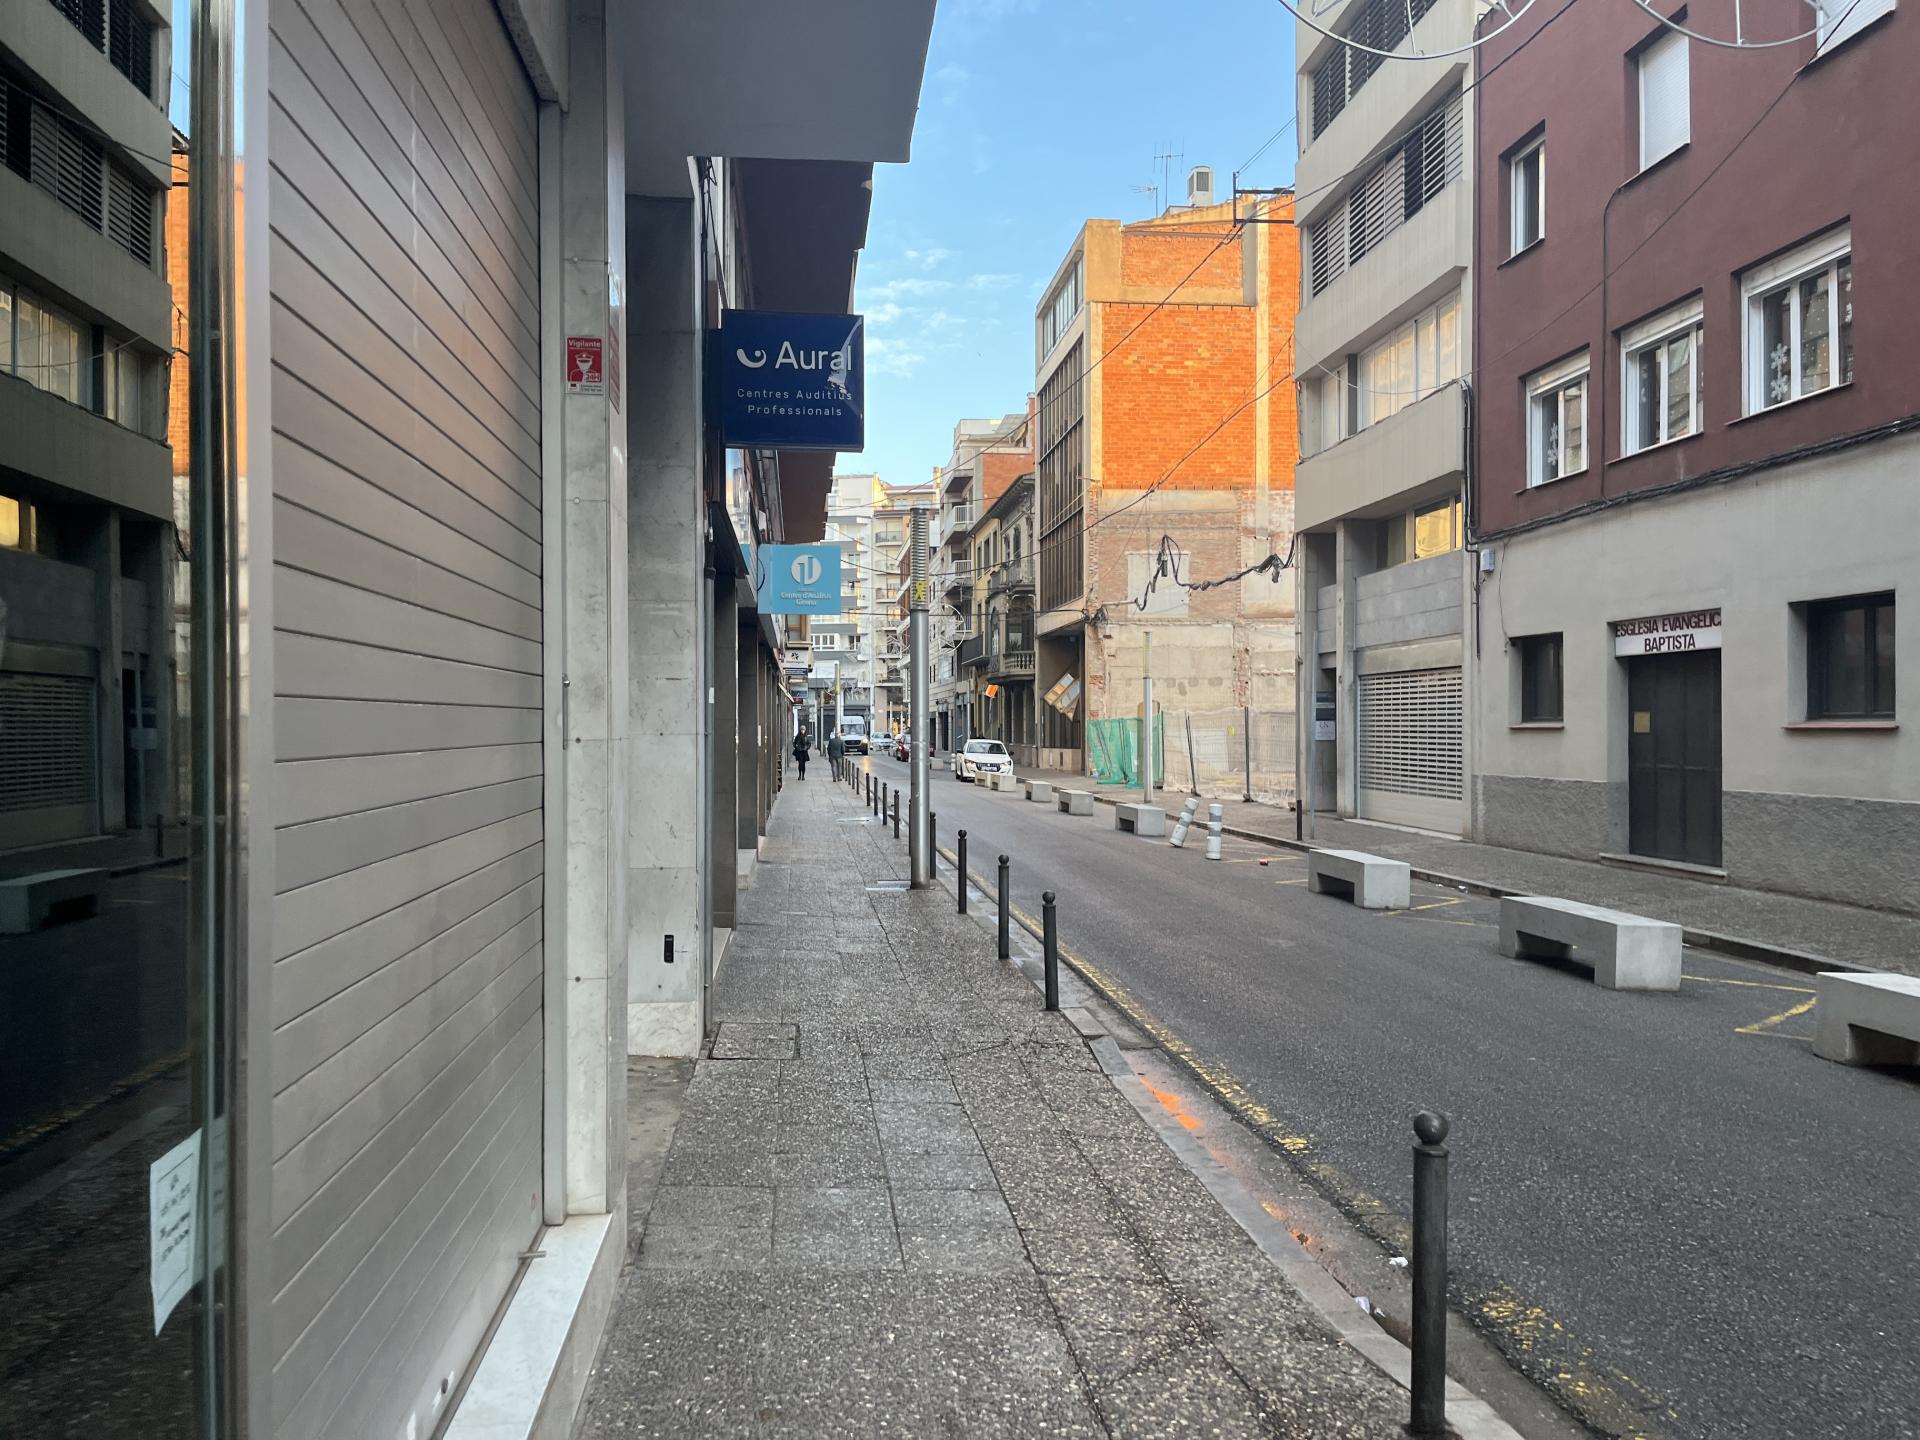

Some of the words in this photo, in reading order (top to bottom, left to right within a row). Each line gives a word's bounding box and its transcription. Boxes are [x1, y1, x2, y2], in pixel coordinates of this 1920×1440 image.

[568, 340, 601, 348] Vigilante
[775, 341, 852, 370] Aural
[737, 388, 789, 399] Centres
[796, 389, 852, 400] Auditius
[747, 405, 842, 416] Professionals
[1615, 619, 1659, 637] ESGLESIA
[1662, 611, 1721, 632] EVANGELIC
[1644, 633, 1696, 652] BAPTISTA
